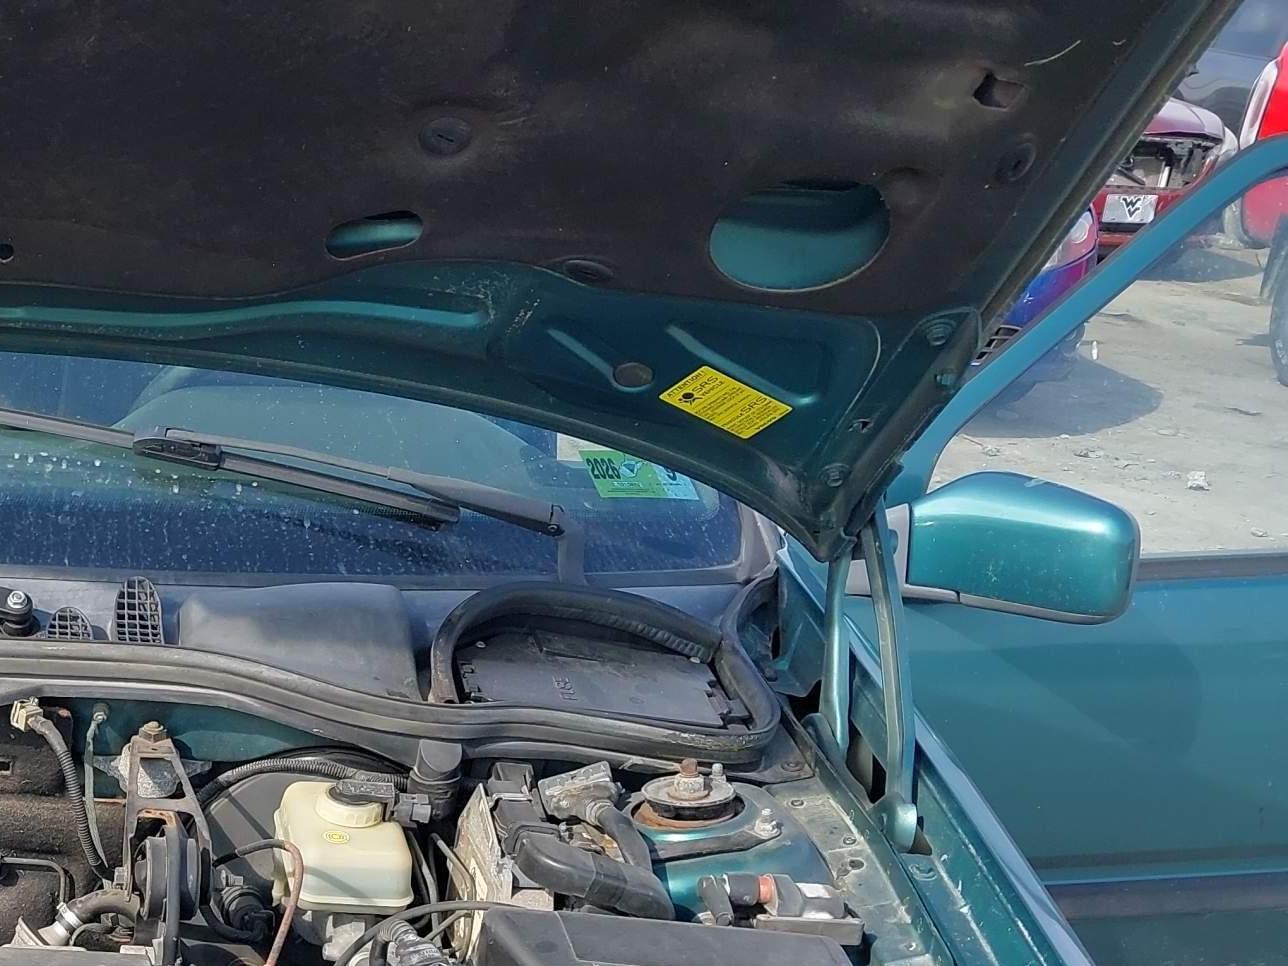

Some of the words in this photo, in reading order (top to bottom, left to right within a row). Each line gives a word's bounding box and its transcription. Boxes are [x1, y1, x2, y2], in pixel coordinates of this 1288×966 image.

[692, 376, 718, 393] SRS
[740, 397, 768, 413] SRS
[586, 458, 621, 479] 2026
